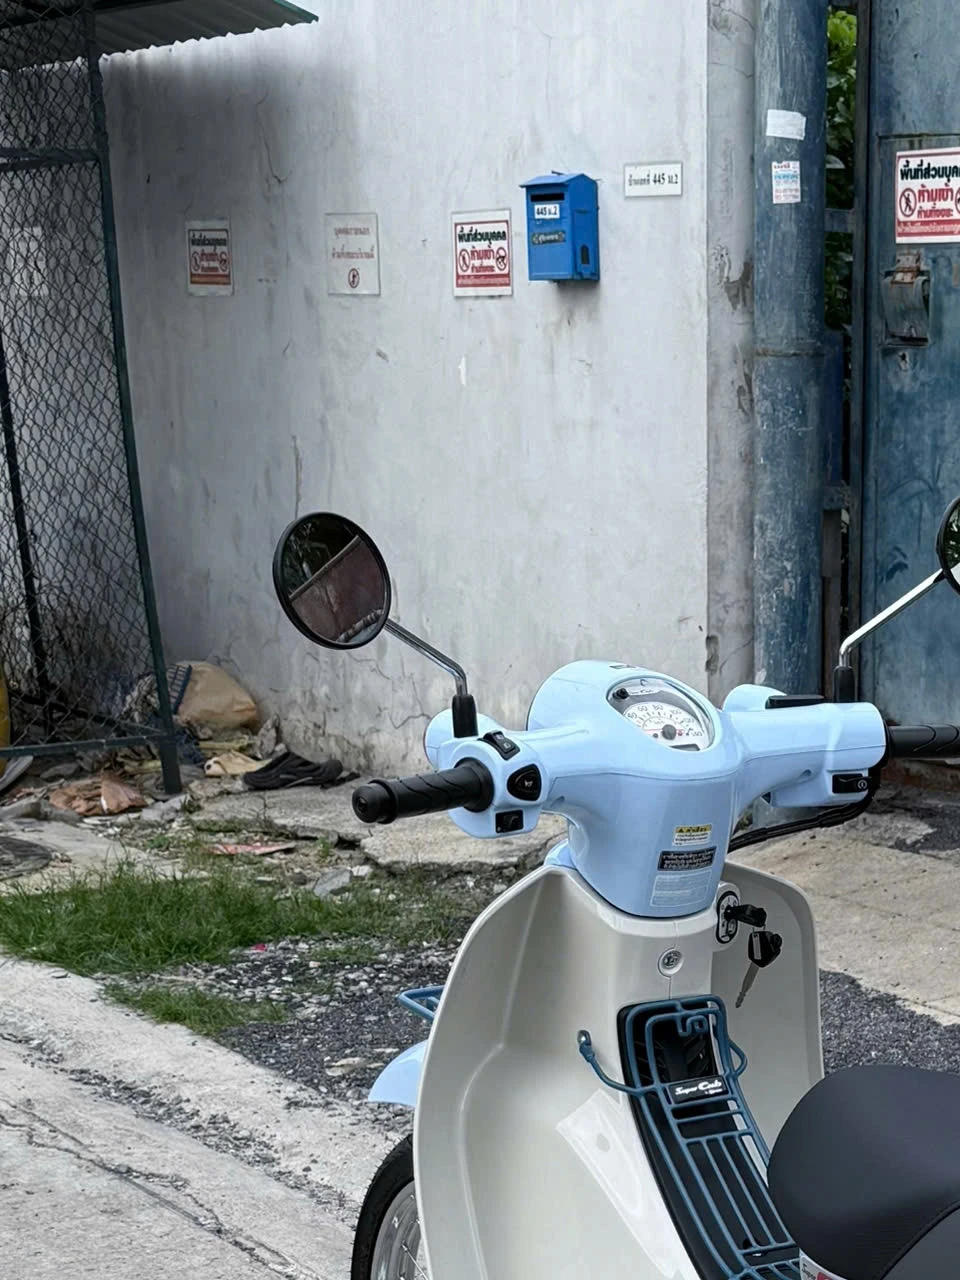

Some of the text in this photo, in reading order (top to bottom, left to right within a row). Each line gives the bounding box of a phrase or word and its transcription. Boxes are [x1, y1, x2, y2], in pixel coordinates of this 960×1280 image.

[653, 172, 665, 185] 445
[917, 184, 954, 203] ห้ามเข้า
[536, 206, 547, 216] 445
[698, 1079, 722, 1091] Cub
